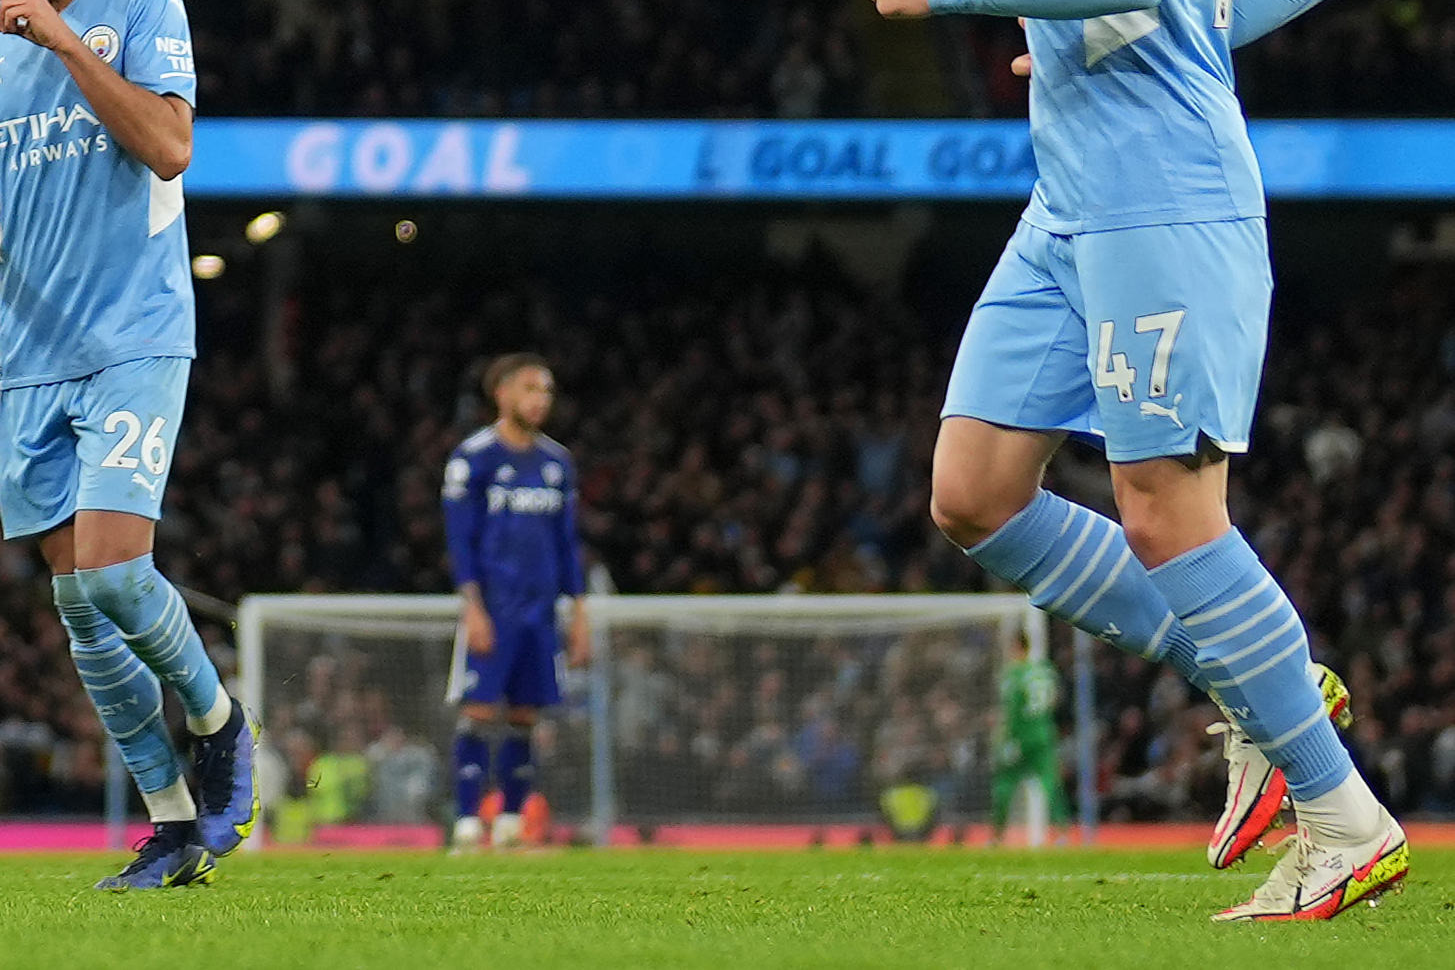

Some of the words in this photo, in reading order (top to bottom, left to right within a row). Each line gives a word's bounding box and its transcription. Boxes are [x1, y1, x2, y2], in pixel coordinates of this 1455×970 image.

[10, 133, 108, 172] AIRWAYS
[286, 121, 531, 194] GOAL
[748, 134, 895, 184] GOAL
[1096, 309, 1187, 403] 47
[101, 410, 168, 475] 26
